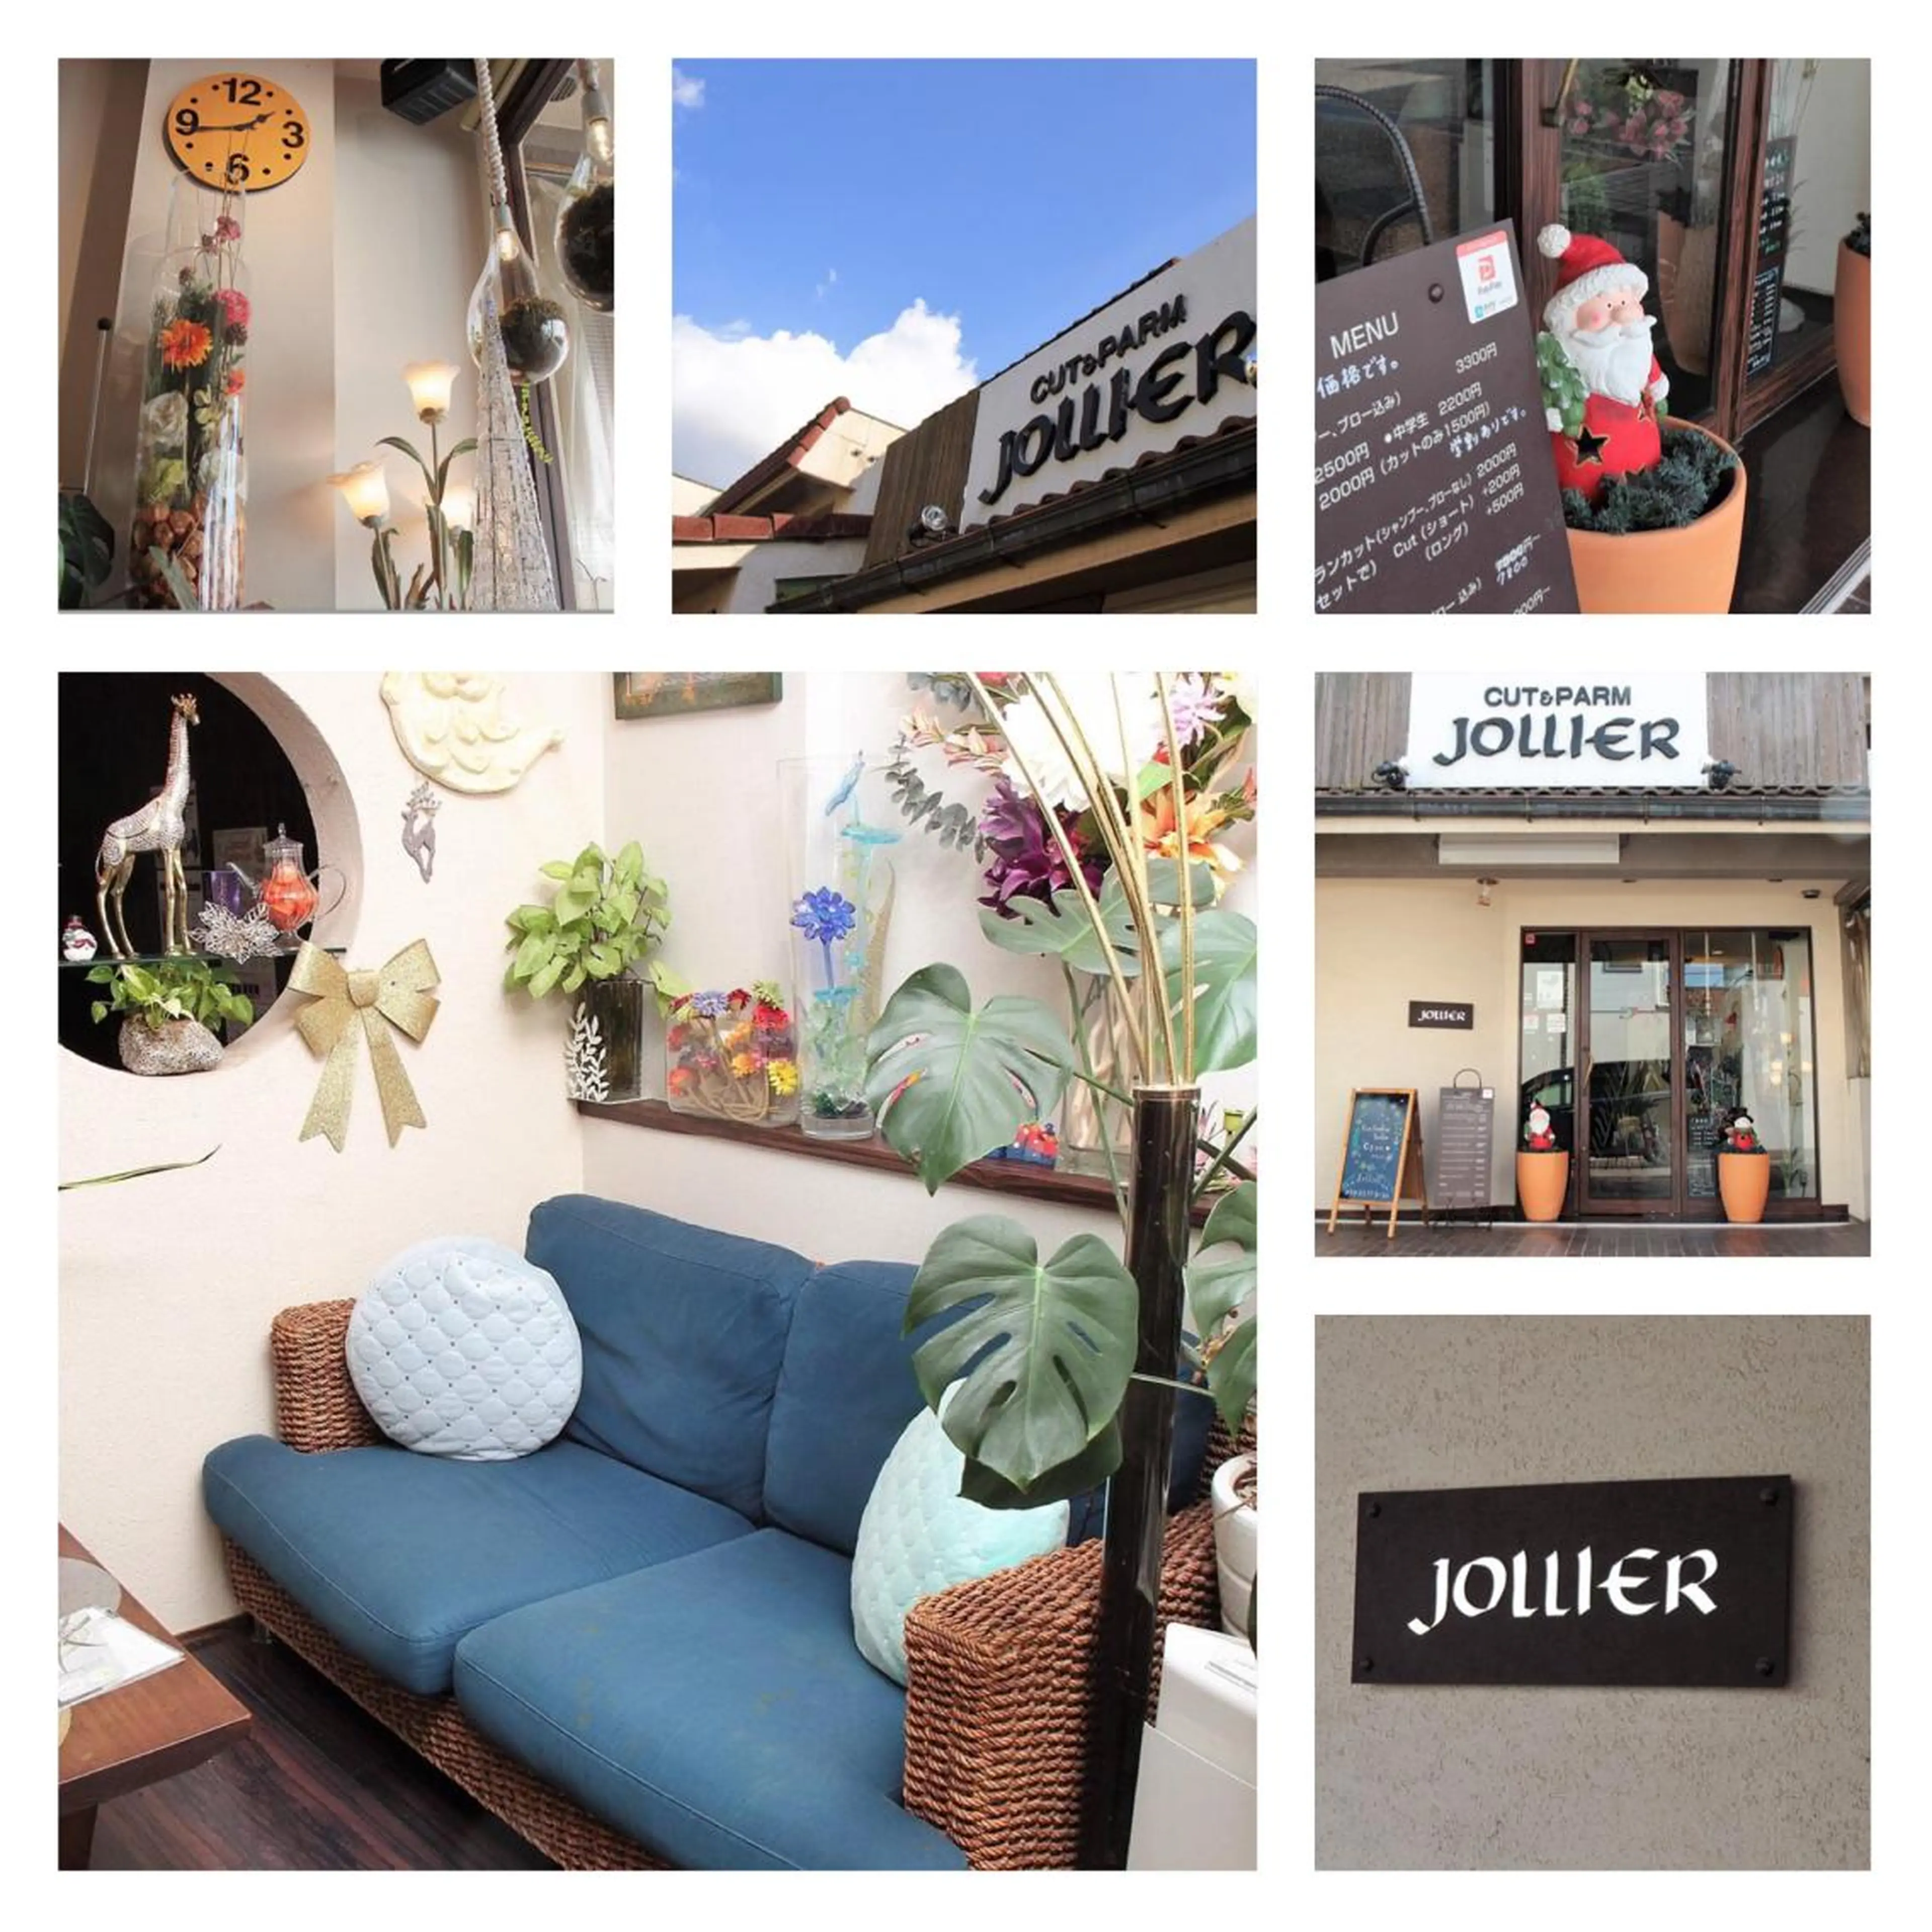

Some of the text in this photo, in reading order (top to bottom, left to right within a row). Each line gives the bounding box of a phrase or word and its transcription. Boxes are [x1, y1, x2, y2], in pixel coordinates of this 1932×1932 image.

[222, 77, 262, 106] 12
[176, 109, 199, 135] 9
[282, 121, 304, 148] 3
[227, 152, 250, 185] 6
[1030, 293, 1188, 404] CUT&PARM
[1330, 311, 1399, 359] MENU
[1317, 354, 1399, 398] 価格です。
[1456, 342, 1498, 374] 3300円
[978, 310, 1256, 505] JOLLIER
[1315, 441, 1370, 485] 2500円
[1438, 381, 1483, 417] 2200円
[1476, 441, 1517, 478] 2000円
[1319, 466, 1375, 511] 2000円
[1393, 533, 1419, 558] Cut
[1484, 686, 1631, 707] CUT&PARM
[1433, 713, 1680, 767] JOLLIER
[1417, 1009, 1466, 1022] JOLLIER
[1408, 1545, 1718, 1635] JOLLIER
